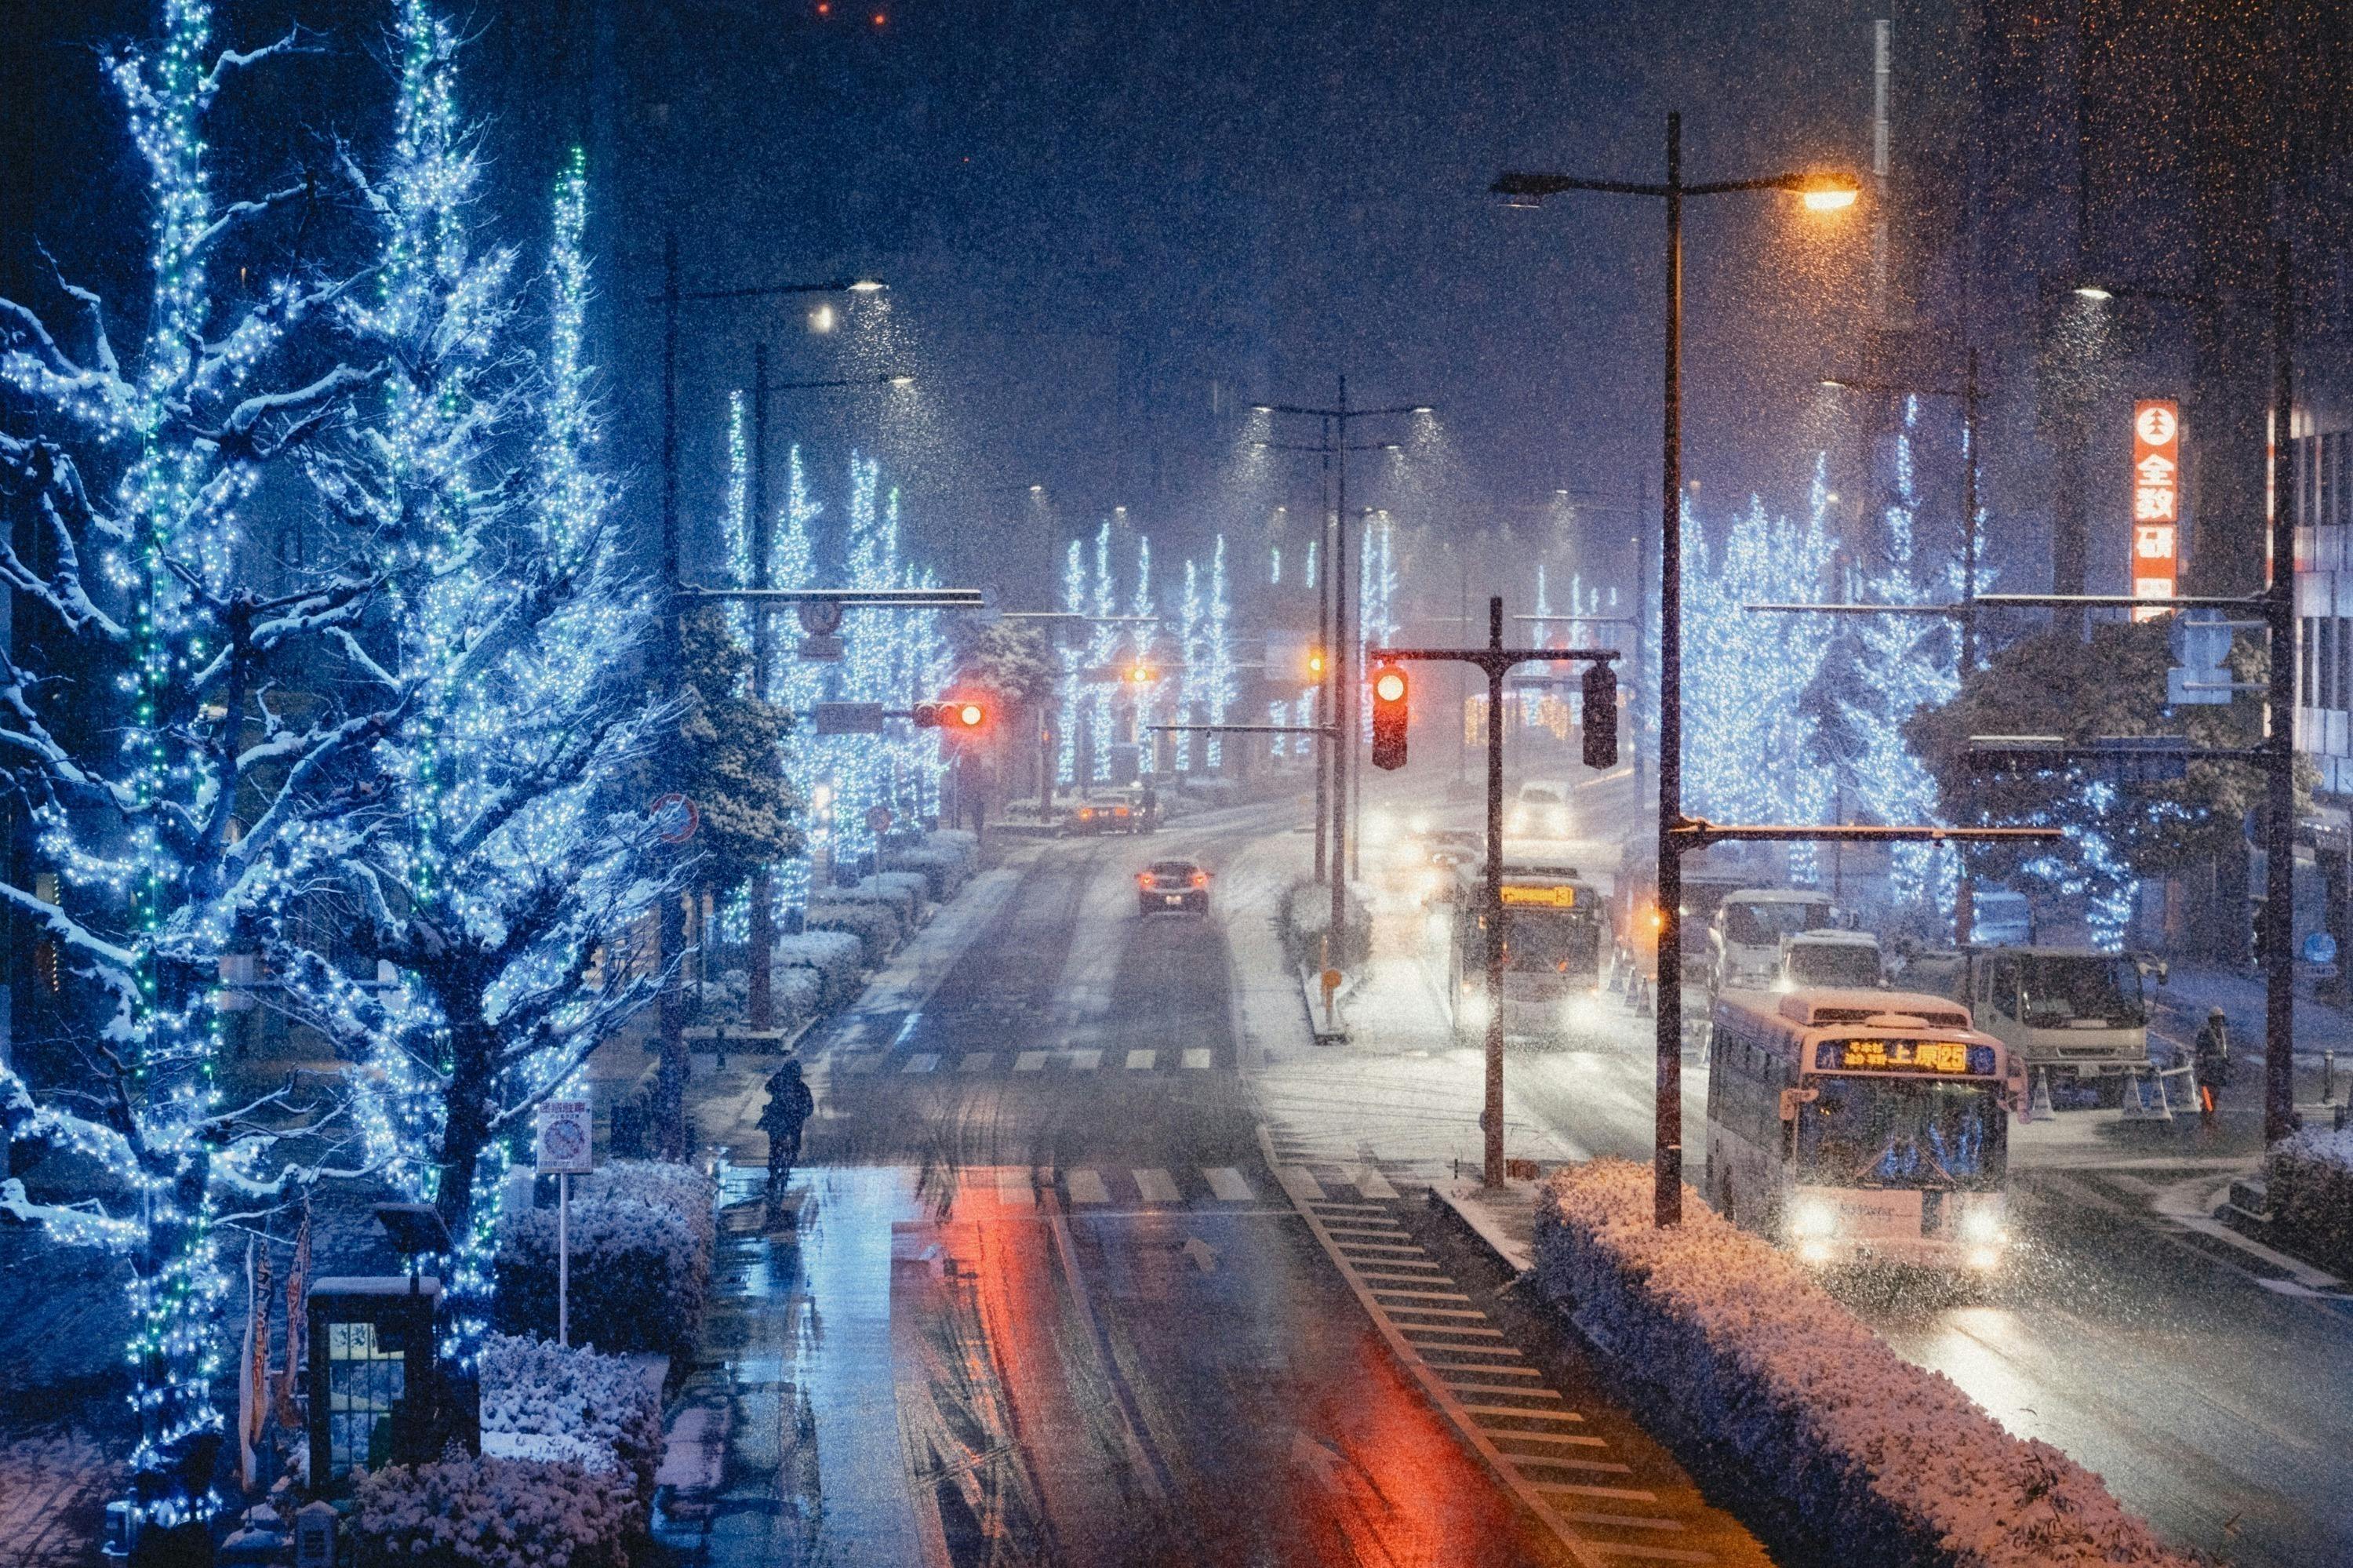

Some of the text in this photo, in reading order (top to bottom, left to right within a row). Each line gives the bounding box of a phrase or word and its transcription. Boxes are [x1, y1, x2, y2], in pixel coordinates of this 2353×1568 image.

[2136, 453, 2174, 558] 全教研
[1888, 1044, 1938, 1067] 上原
[1940, 1046, 1964, 1068] 25
